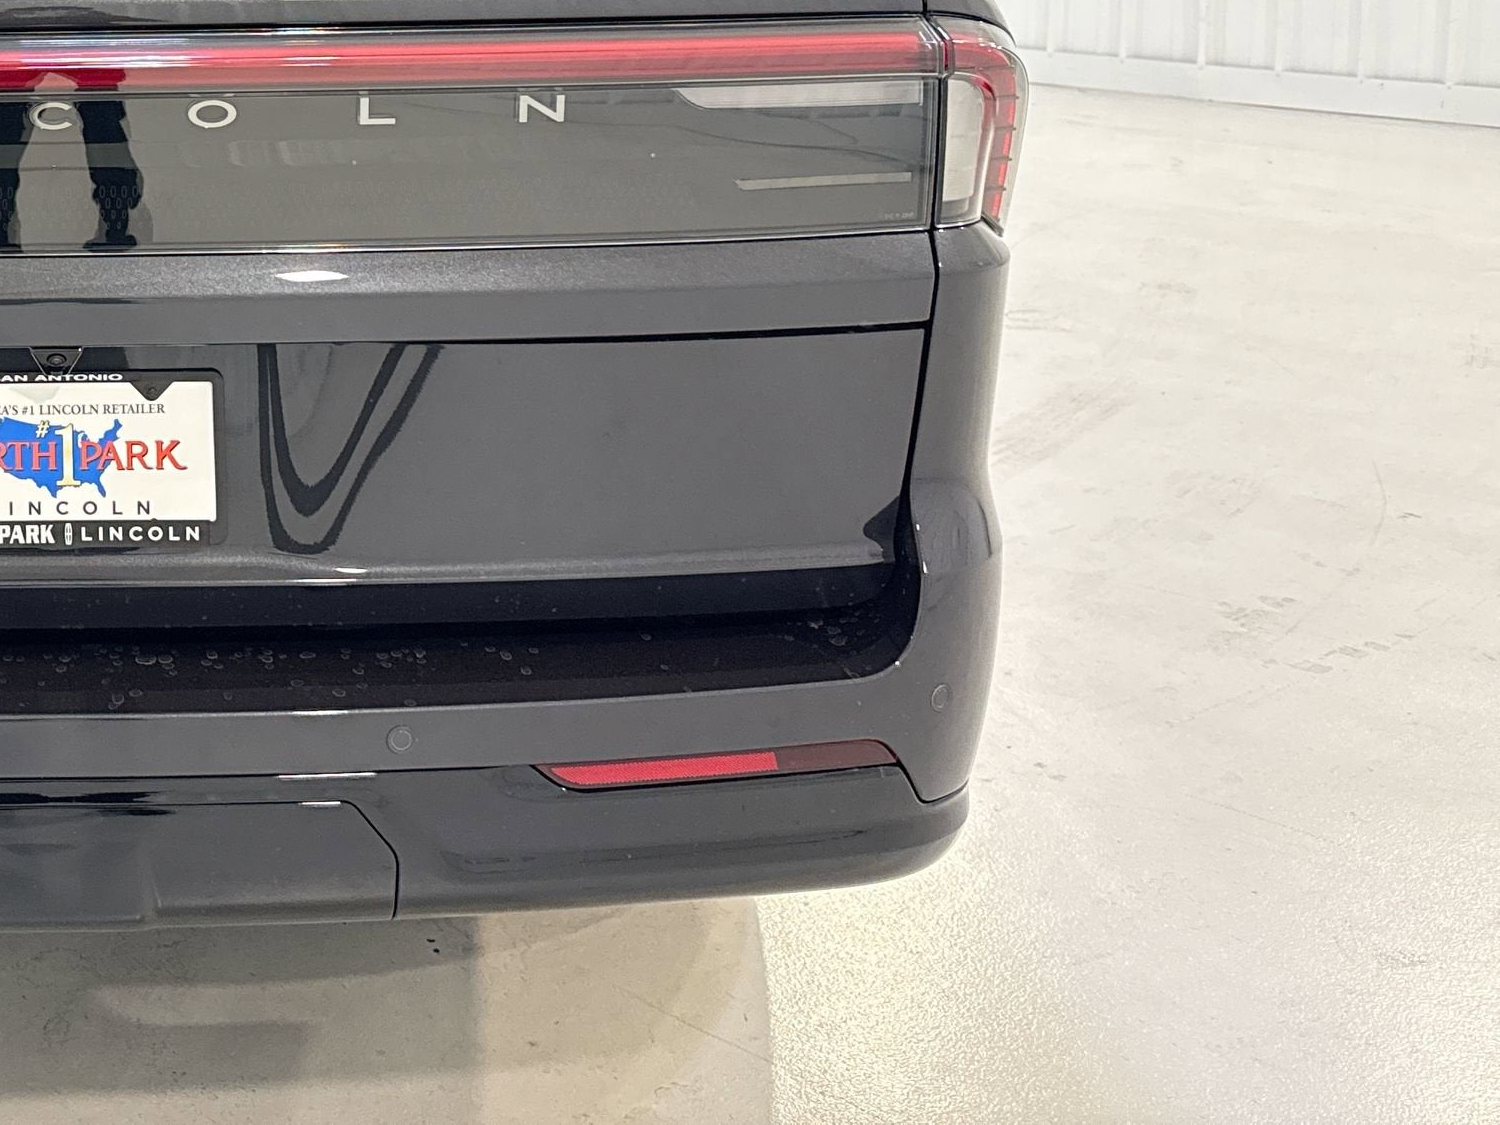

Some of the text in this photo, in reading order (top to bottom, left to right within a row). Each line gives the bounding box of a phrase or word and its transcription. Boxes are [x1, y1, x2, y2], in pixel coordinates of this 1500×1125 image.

[35, 373, 123, 382] ANTONIO
[22, 404, 35, 416] #1
[39, 403, 99, 416] LINCOLN
[103, 403, 165, 415] RETAILER
[80, 440, 188, 471] PARK
[81, 525, 200, 542] LINCOLN
